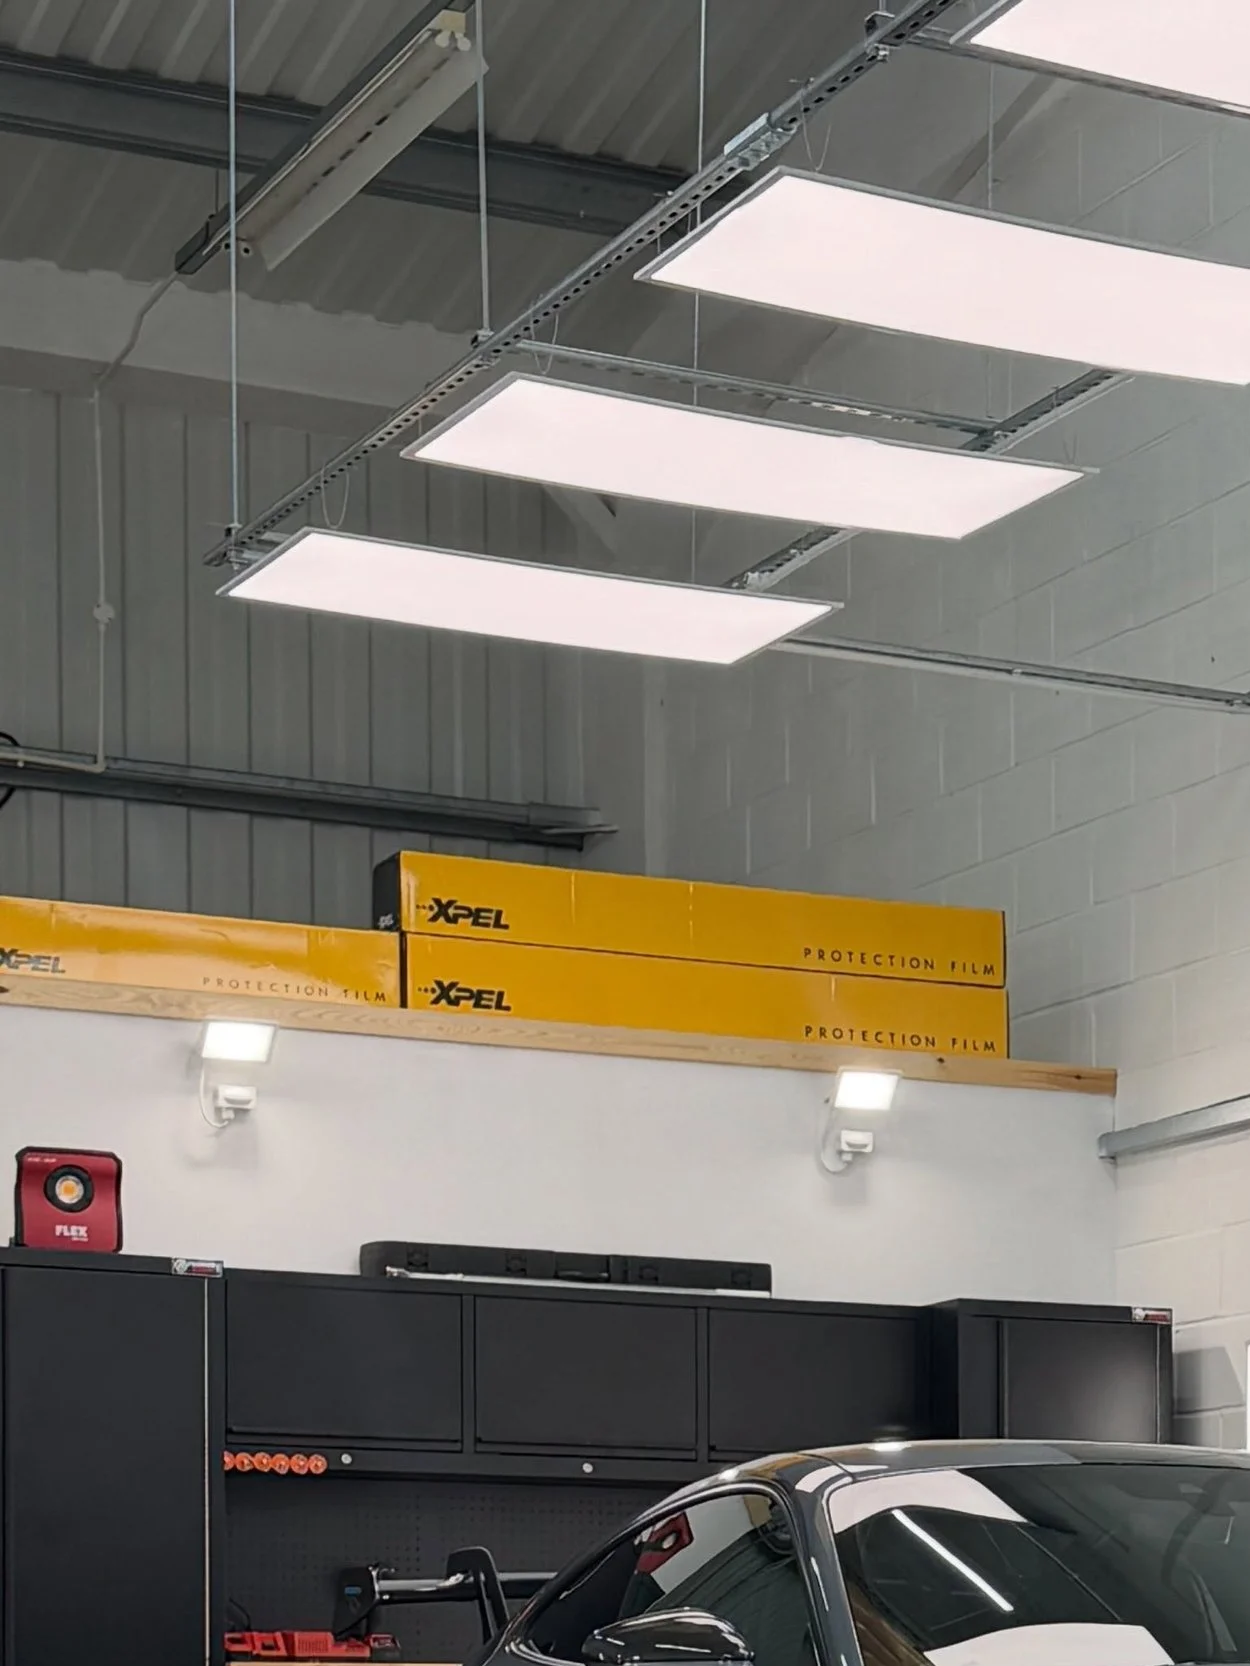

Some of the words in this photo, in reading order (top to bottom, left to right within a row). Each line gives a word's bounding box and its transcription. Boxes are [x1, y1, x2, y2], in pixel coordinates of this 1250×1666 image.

[427, 897, 510, 930] XPEL
[803, 947, 936, 970] PROTECTION
[950, 961, 996, 976] FILM
[202, 976, 329, 997] PROTECTION
[430, 979, 512, 1012] XPEL
[804, 1025, 937, 1048] PROTECTION
[951, 1037, 996, 1052] FILM
[55, 1224, 89, 1237] FLEX
